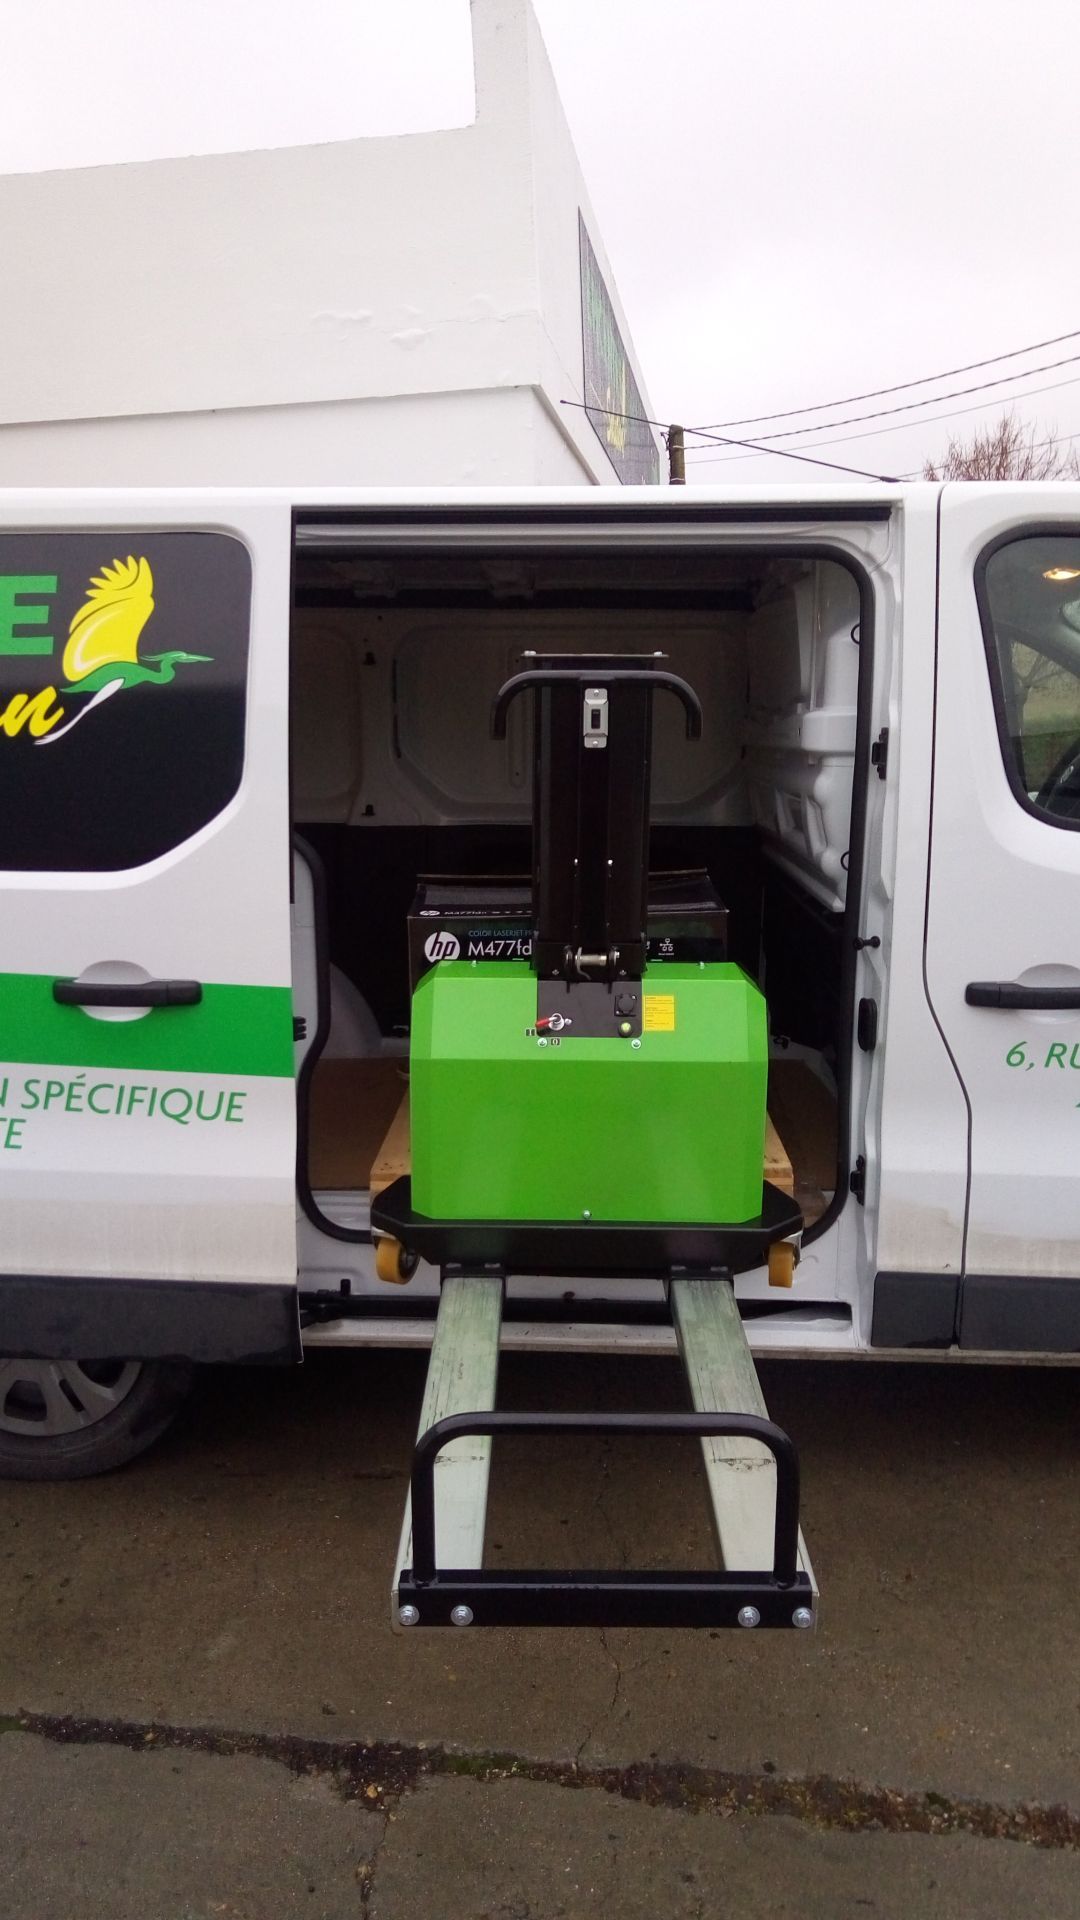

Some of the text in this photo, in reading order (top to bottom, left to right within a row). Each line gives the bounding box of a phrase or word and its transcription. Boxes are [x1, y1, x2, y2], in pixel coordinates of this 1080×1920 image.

[429, 931, 456, 961] hp
[493, 929, 524, 937] LASERJET
[1006, 1041, 1035, 1071] 6,
[21, 1073, 247, 1125] SPÉCIFIQUE
